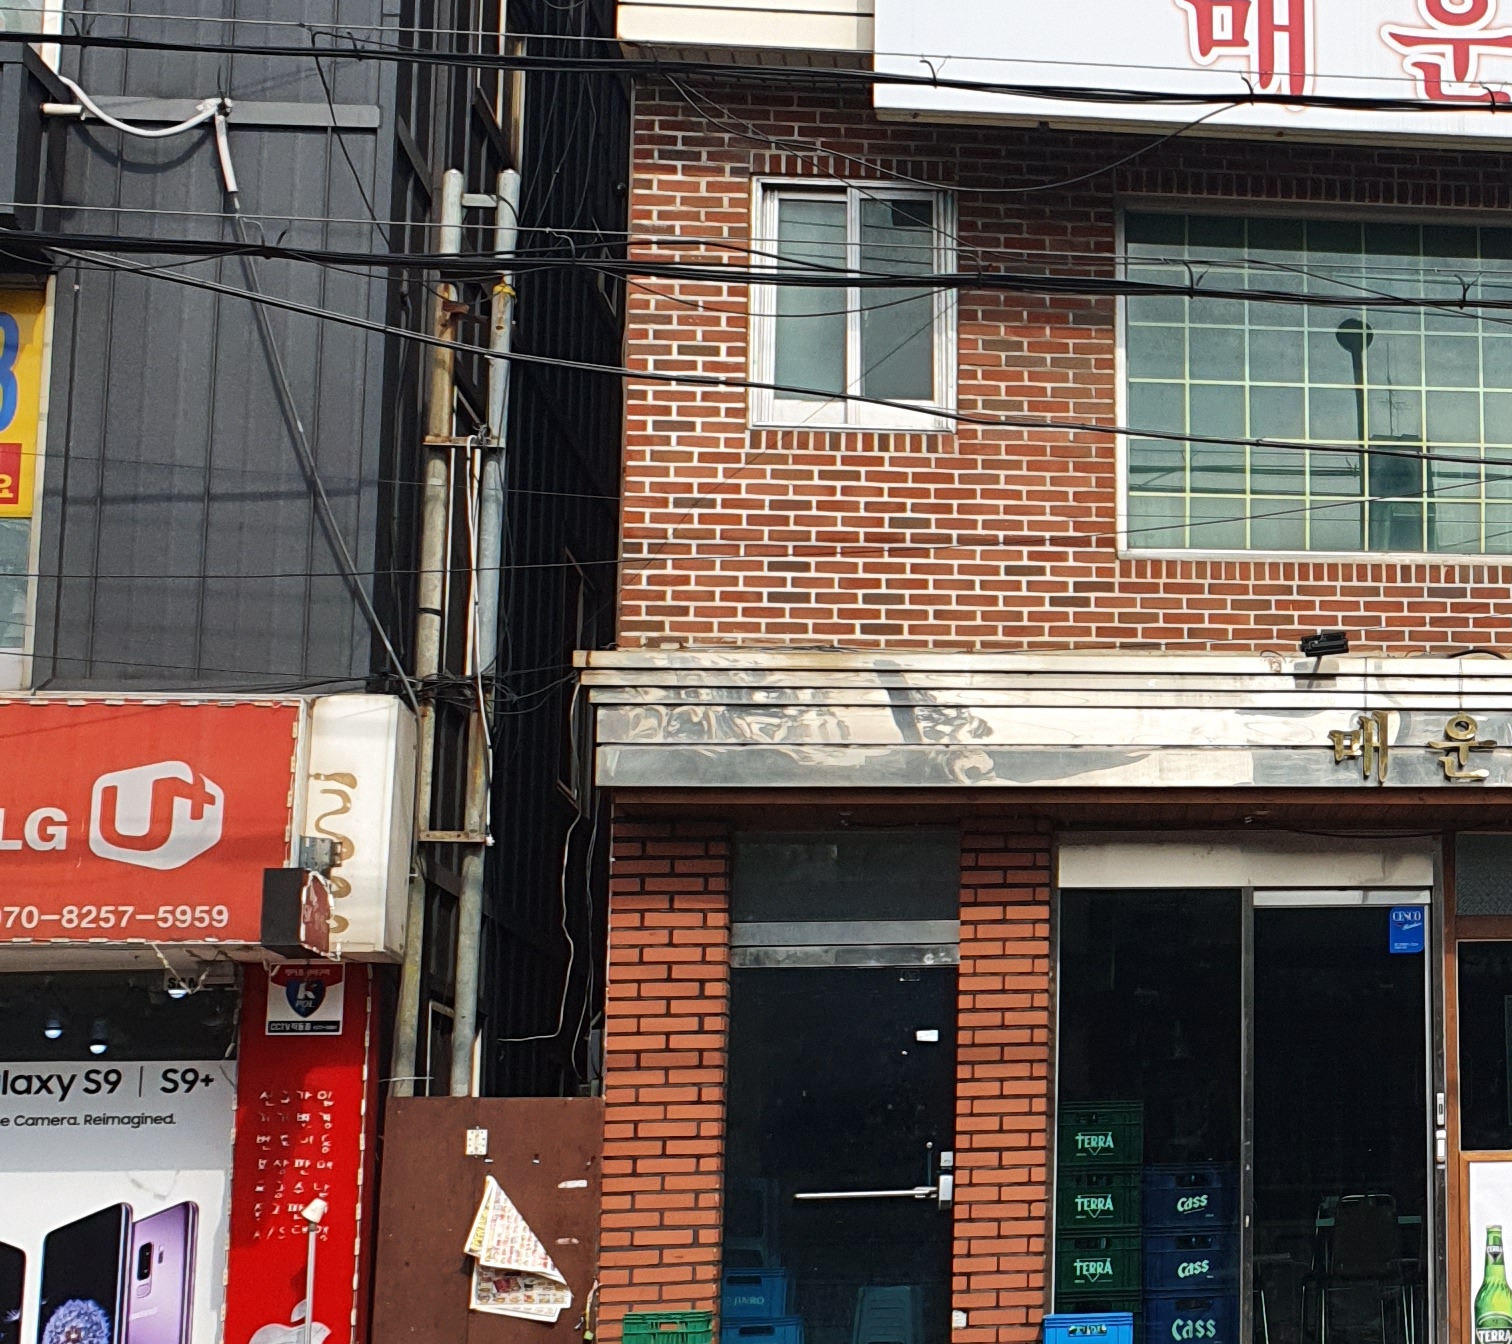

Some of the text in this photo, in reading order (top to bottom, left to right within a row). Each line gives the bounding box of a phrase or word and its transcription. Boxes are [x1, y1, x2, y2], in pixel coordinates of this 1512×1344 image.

[0, 807, 68, 851] LG
[0, 904, 229, 931] 70-8257-5959
[0, 1068, 214, 1102] laxy S9 S9+
[14, 1114, 80, 1127] Camera.
[83, 1113, 177, 1129] Reimagined.
[1075, 1131, 1114, 1149] TERRA
[254, 1202, 328, 1221] 중고판
[1075, 1193, 1114, 1212] TERRA
[1176, 1194, 1208, 1213] Cass
[1073, 1257, 1113, 1276] TERRA
[1177, 1259, 1210, 1279] Cass
[1171, 1317, 1217, 1342] Cass
[1478, 1329, 1512, 1343] TERRA
